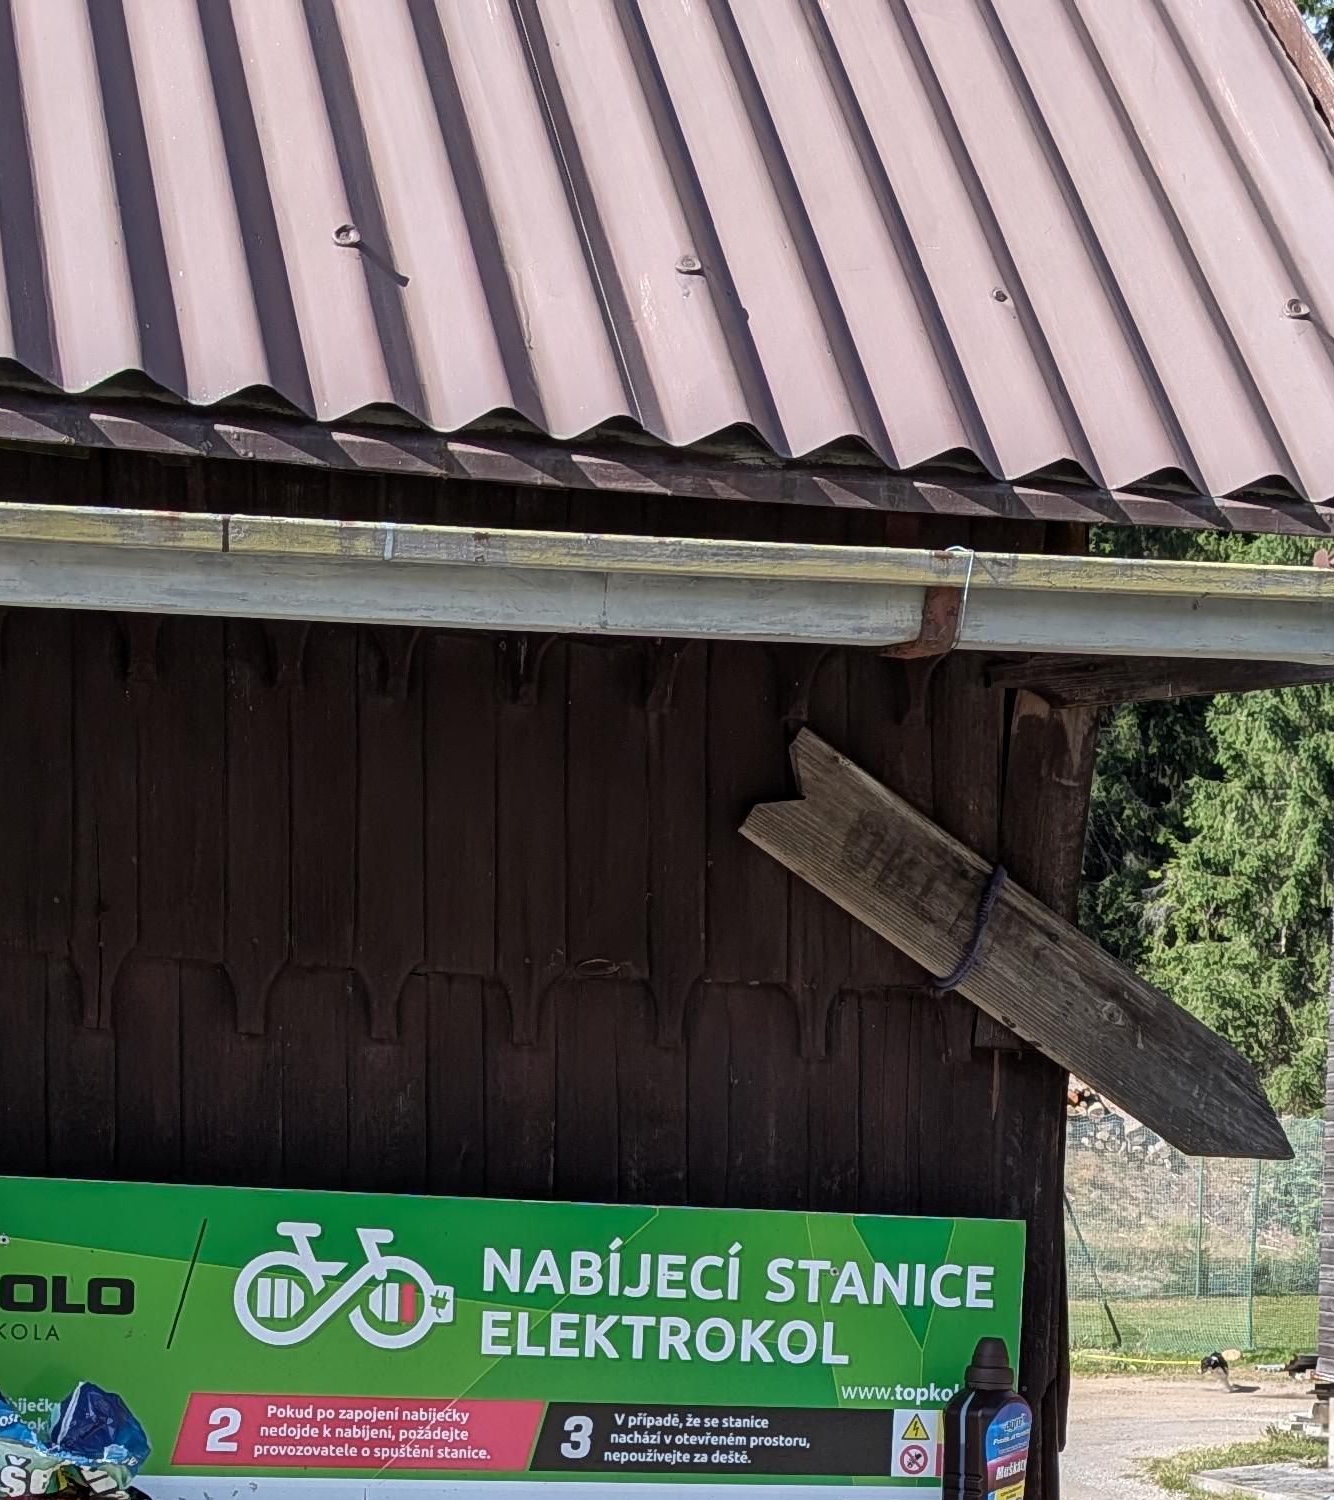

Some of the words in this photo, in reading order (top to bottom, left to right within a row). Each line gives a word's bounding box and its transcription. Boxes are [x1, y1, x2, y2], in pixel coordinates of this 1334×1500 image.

[482, 1238, 741, 1300] NABÍJECÍ
[766, 1257, 995, 1309] STANICE
[481, 1311, 850, 1366] ELEKTROKOL
[267, 1404, 313, 1418] Pokud
[316, 1408, 335, 1421] po
[338, 1406, 400, 1423] zapojení
[614, 1413, 626, 1427] V
[628, 1413, 683, 1430] případě,
[685, 1413, 701, 1428] že
[704, 1416, 719, 1428] se
[722, 1415, 769, 1429] stanice
[205, 1407, 242, 1453] 2
[260, 1423, 319, 1440] nedojde
[322, 1424, 332, 1438] k
[335, 1424, 396, 1441] nabíjení,
[398, 1426, 469, 1443] požádejte
[560, 1415, 594, 1459] 3
[610, 1431, 661, 1445] nachází
[663, 1434, 672, 1445] v
[674, 1431, 747, 1447] otevřeném
[750, 1434, 811, 1448] prostoru,
[253, 1443, 358, 1458] provozovatele
[361, 1447, 370, 1457] o
[373, 1444, 434, 1460] spuštění
[437, 1445, 491, 1460] stanice.
[603, 1449, 690, 1466] nepoužívejte
[693, 1452, 708, 1464] za
[711, 1450, 752, 1465] deště.
